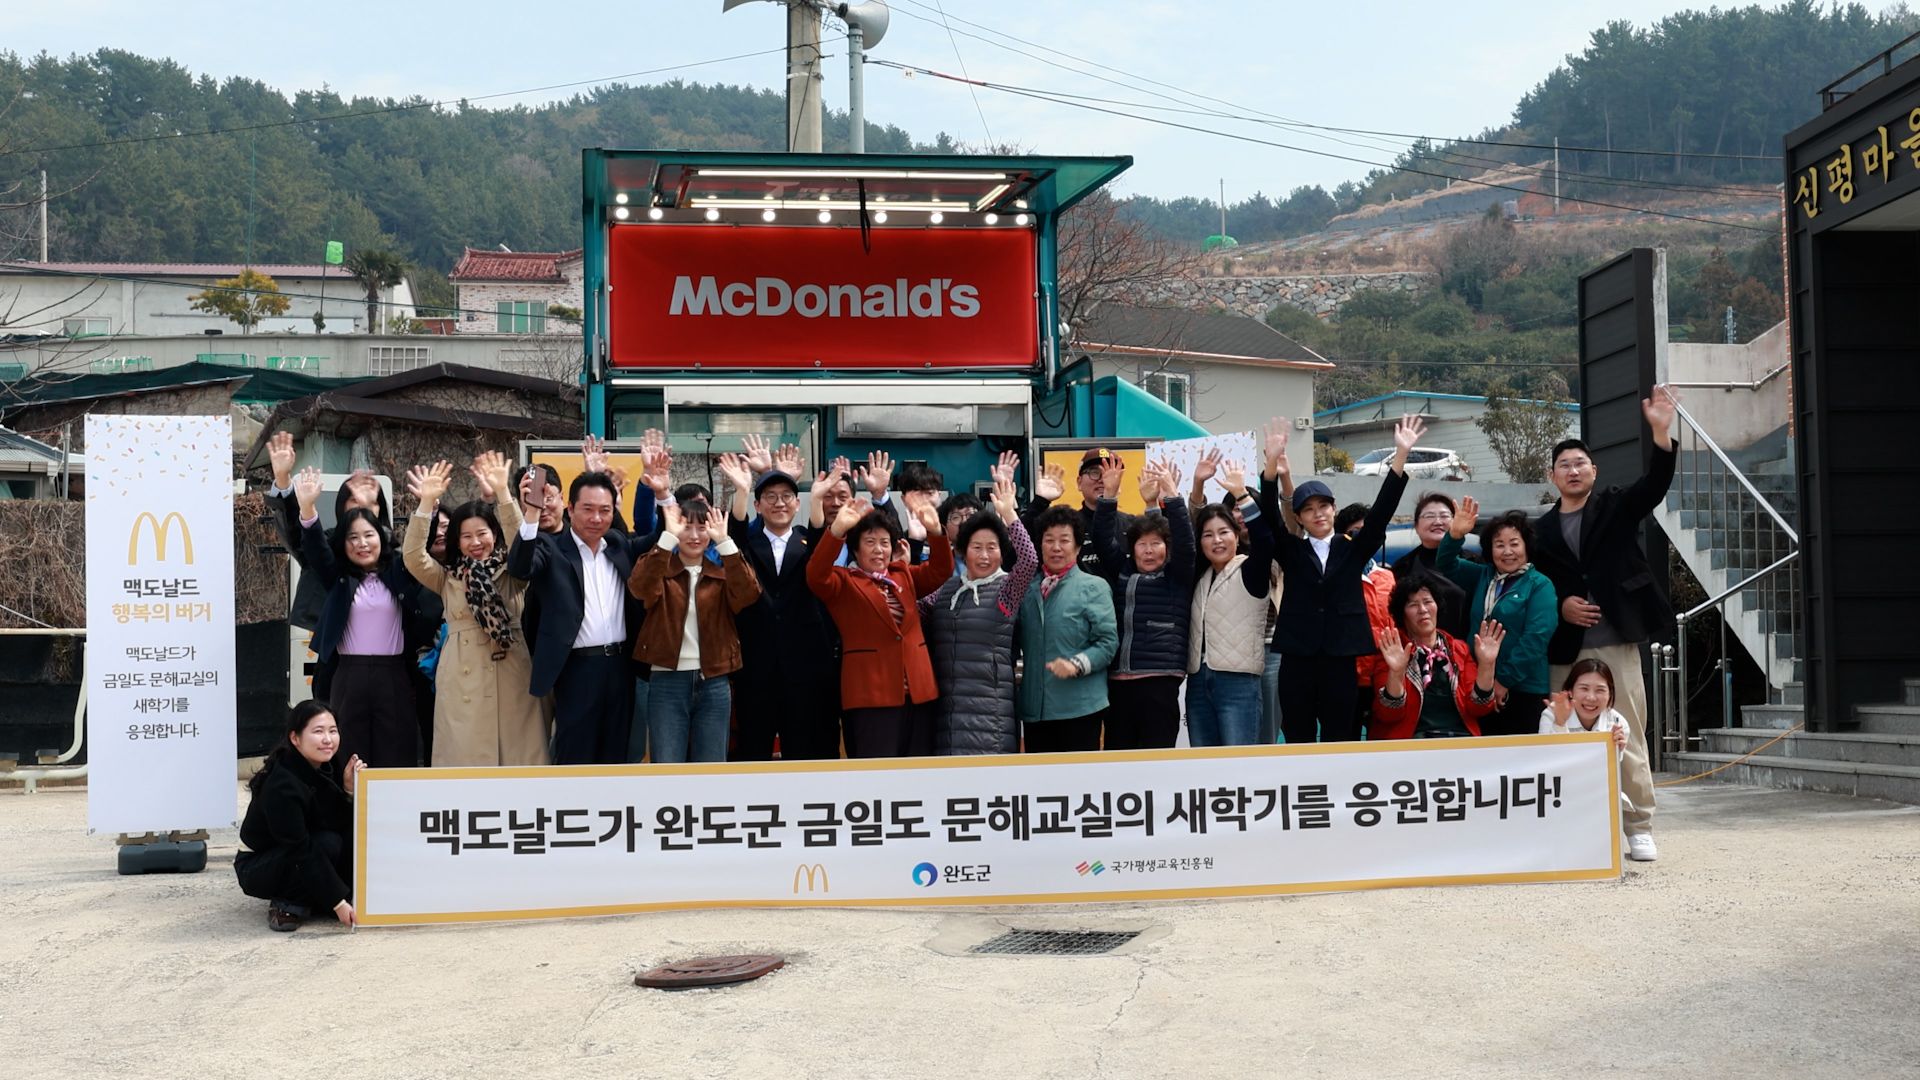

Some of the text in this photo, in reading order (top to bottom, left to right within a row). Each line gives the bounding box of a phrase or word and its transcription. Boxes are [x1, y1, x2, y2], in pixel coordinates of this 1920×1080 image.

[669, 276, 980, 318] McDonald's
[123, 578, 200, 598] 맥도날드
[111, 602, 211, 624] 행복의 버거
[126, 645, 196, 662] 맥도날드가
[103, 670, 218, 689] 금일도 문해교실의
[133, 697, 190, 713] 새학기를
[126, 722, 200, 740] 응원합니다.
[419, 773, 1562, 856] 맥도날드가 완도군 금일도 문해교실의 새학기를 응원합니다!
[943, 864, 992, 883] 완도군
[1111, 857, 1214, 874] 국가평생교육진흥원
